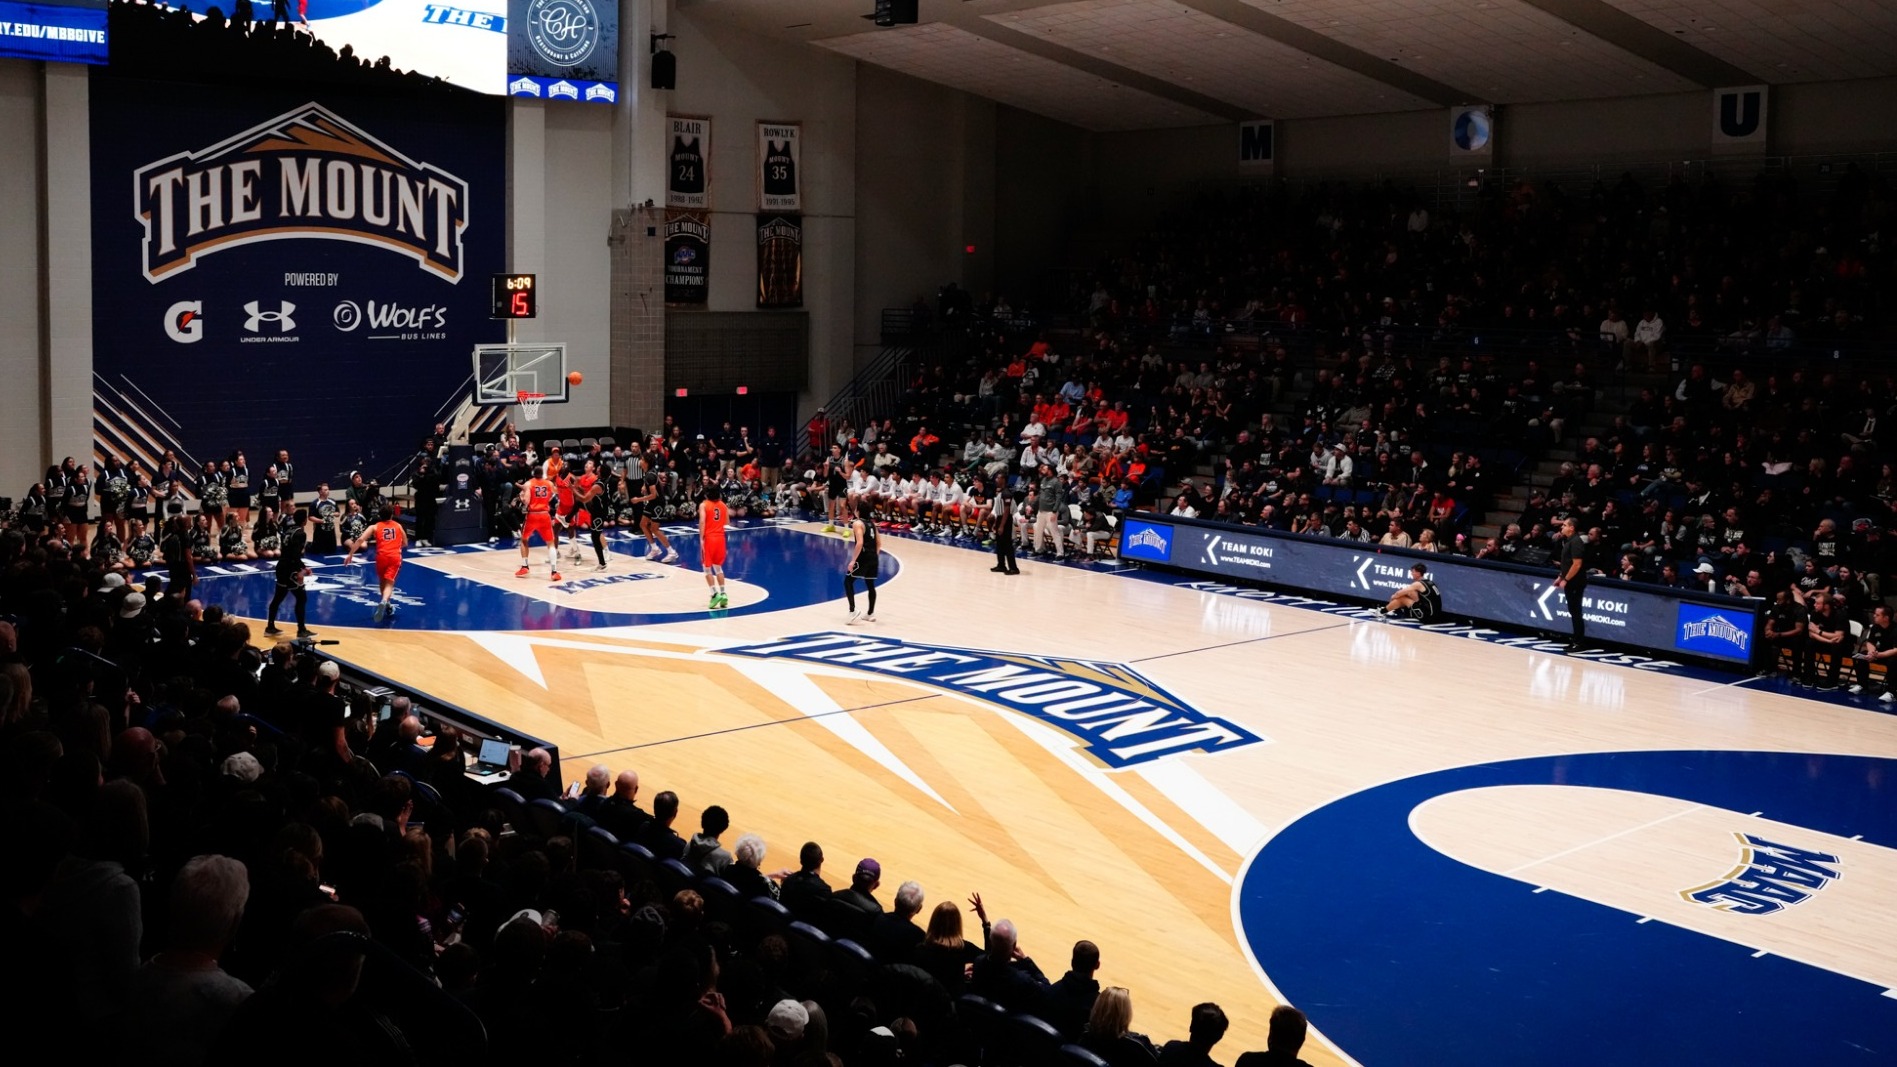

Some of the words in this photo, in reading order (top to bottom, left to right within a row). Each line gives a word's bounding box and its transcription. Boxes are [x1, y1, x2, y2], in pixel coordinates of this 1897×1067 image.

[422, 4, 494, 30] THE
[1720, 92, 1760, 137] U
[674, 121, 701, 134] BLAIR
[1242, 126, 1272, 160] M
[675, 153, 699, 163] MOUNT
[769, 155, 790, 165] MOUNT
[679, 165, 695, 181] 24
[772, 165, 788, 180] 35
[150, 159, 261, 256] THE
[278, 157, 457, 259] MOUNT
[665, 221, 680, 237] THE
[681, 221, 707, 240] MOUNT
[760, 226, 774, 241] THE
[284, 273, 326, 287] POWERED
[328, 273, 339, 287] BY
[507, 277, 531, 290] 6:09
[665, 275, 705, 286] CHAMPIONS
[401, 333, 419, 341] BUS
[421, 332, 447, 341] LINES
[534, 486, 547, 498] 23
[713, 507, 721, 521] 3
[382, 528, 396, 541] 21
[1222, 541, 1247, 554] TEAM
[1250, 545, 1273, 558] KOKI
[1374, 564, 1404, 578] TEAM
[1407, 569, 1434, 581] KKI
[1557, 593, 1593, 608] TM
[1597, 599, 1629, 614] KOKI
[1683, 621, 1707, 641] THE
[1707, 621, 1748, 651] MOUNT
[738, 634, 982, 673] THE
[927, 664, 1245, 760] MOUNT
